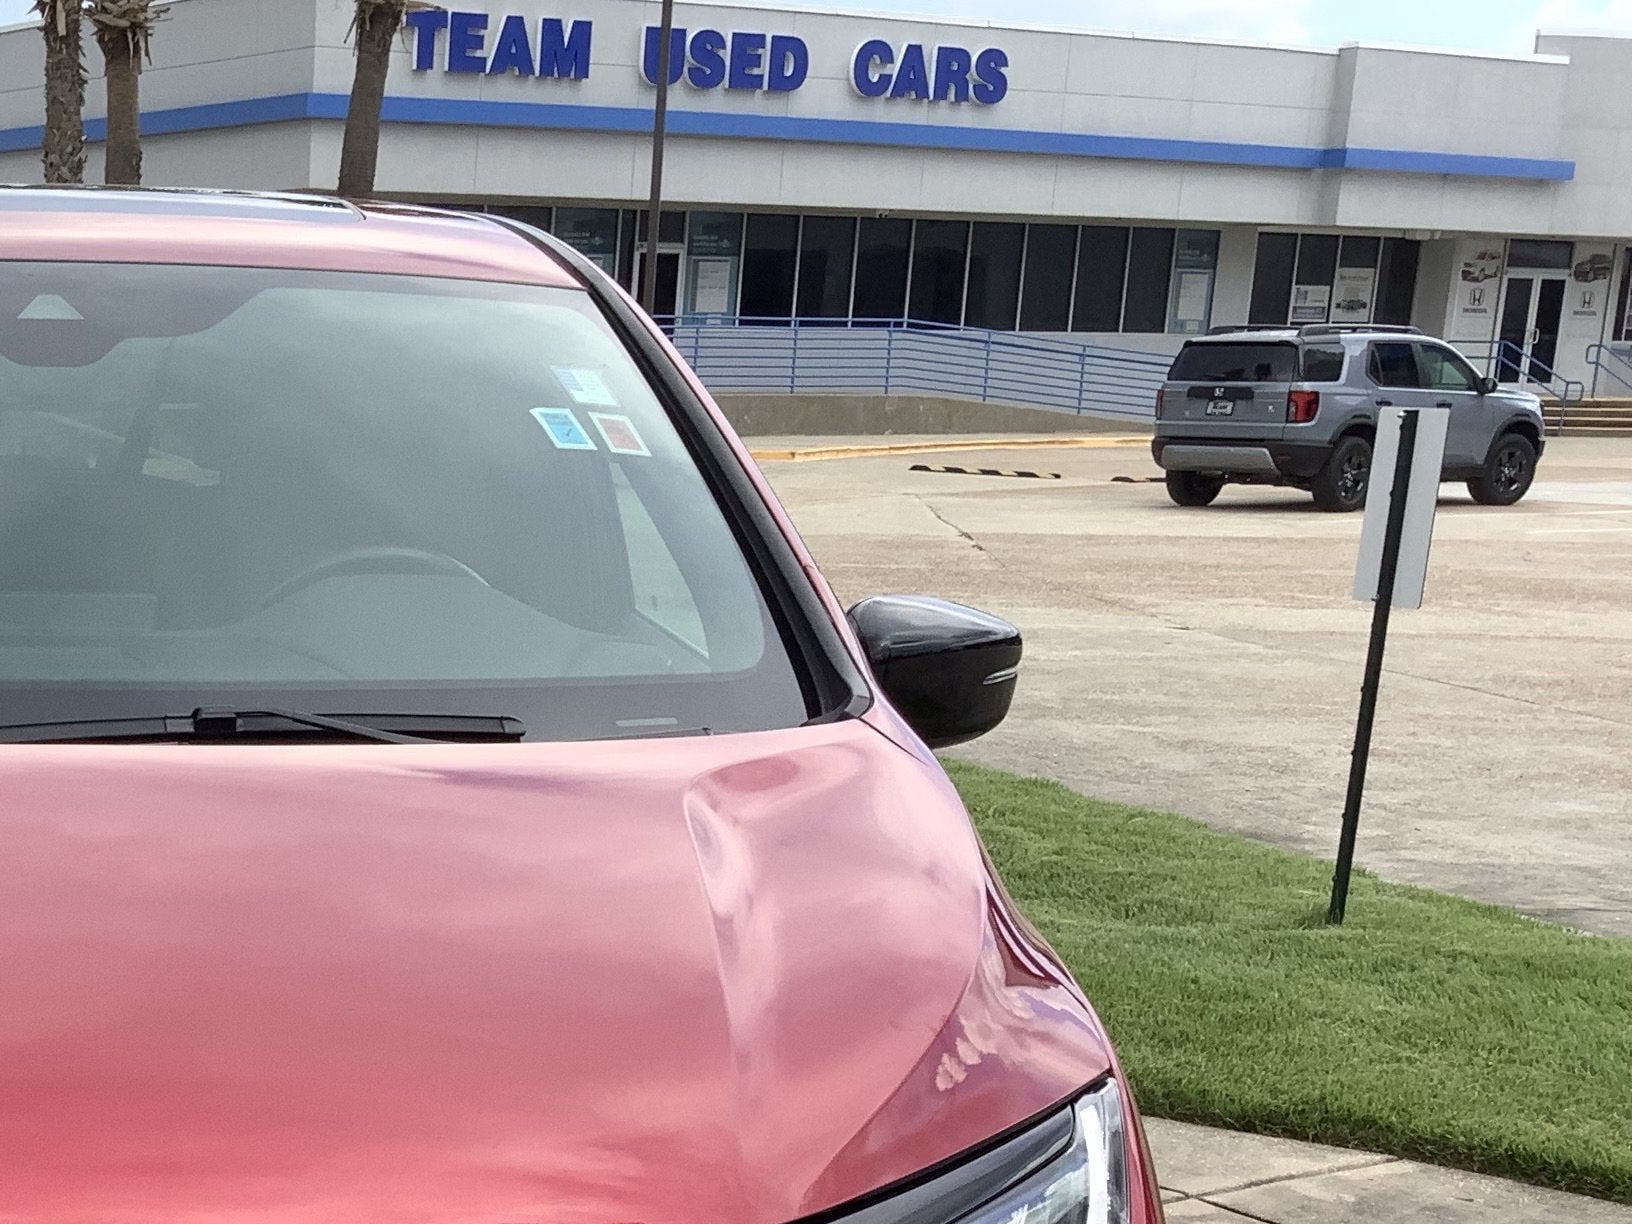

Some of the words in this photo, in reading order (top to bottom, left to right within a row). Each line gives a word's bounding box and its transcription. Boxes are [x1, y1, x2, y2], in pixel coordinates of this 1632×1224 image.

[405, 11, 593, 80] TEAM
[639, 25, 809, 91] USED
[850, 38, 1009, 105] CARS
